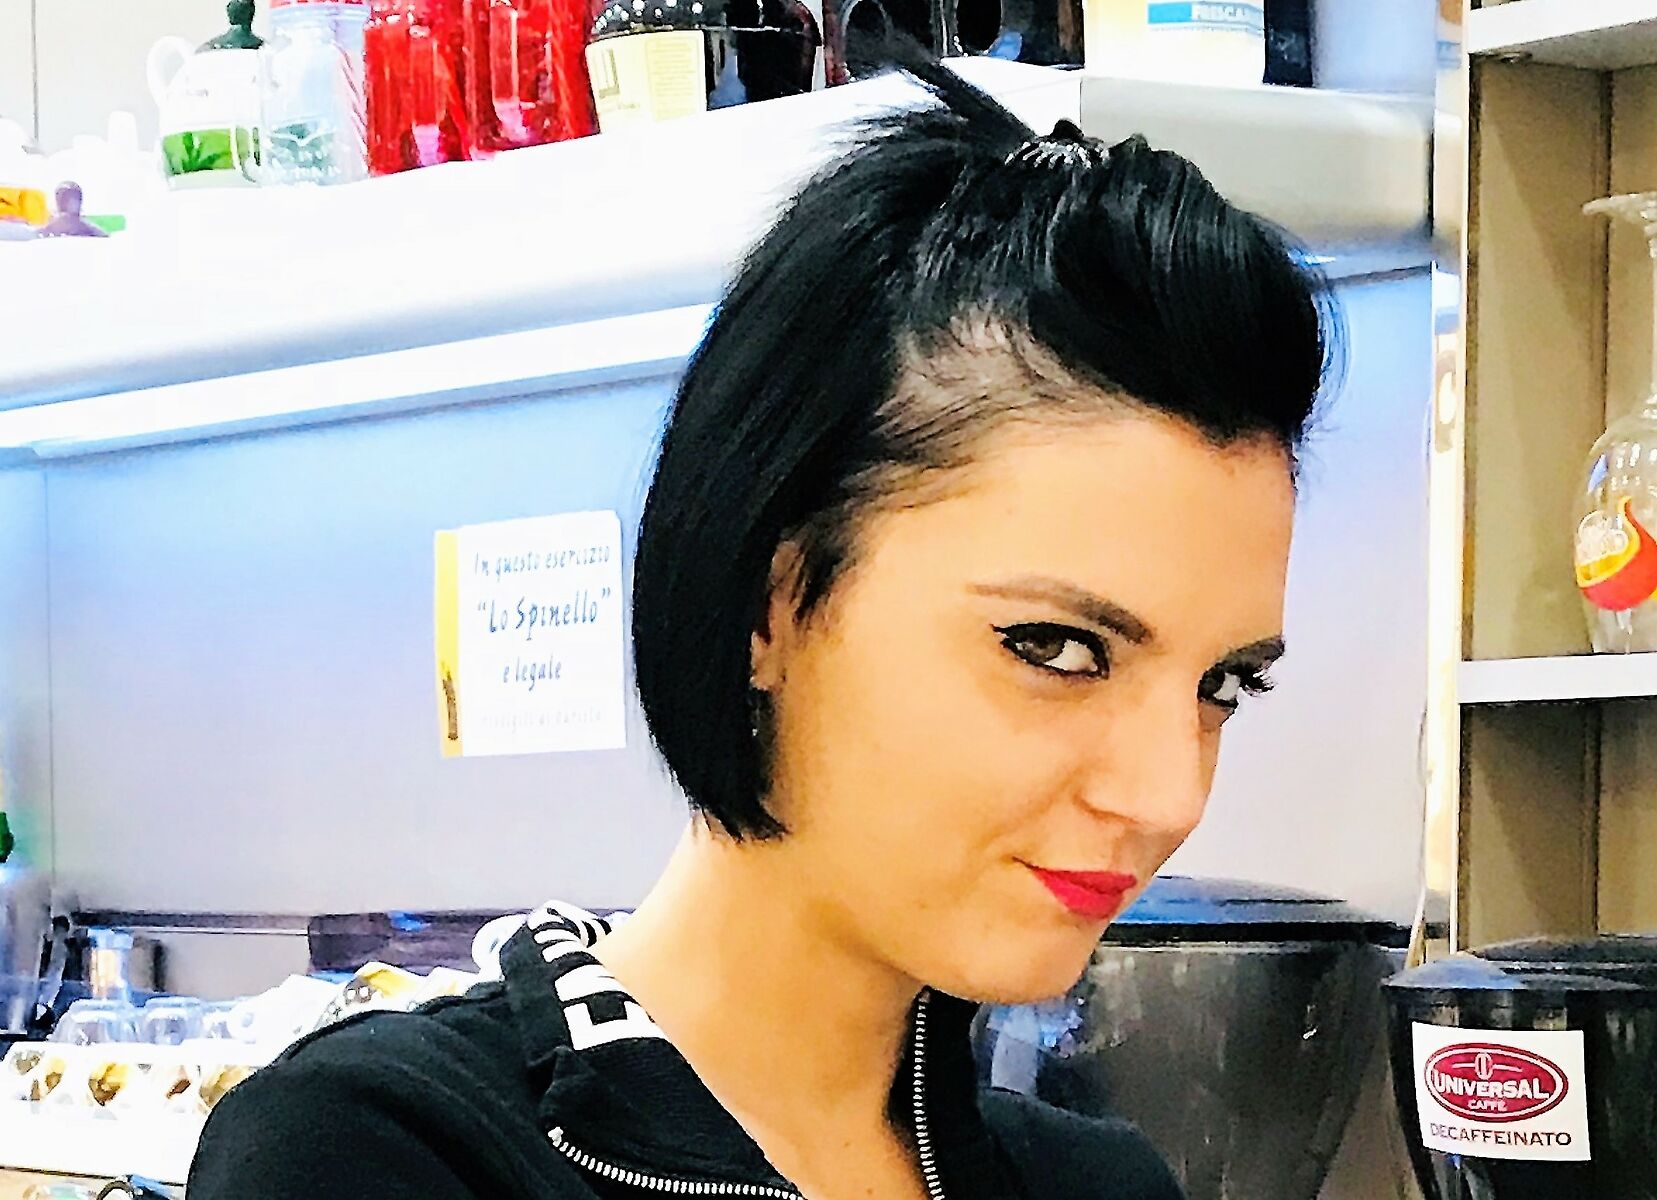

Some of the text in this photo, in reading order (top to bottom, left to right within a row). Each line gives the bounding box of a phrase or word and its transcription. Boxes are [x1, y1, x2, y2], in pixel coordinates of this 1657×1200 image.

[474, 551, 489, 577] In
[495, 550, 541, 583] questo
[515, 651, 562, 693] legale
[1431, 1067, 1550, 1100] UNIVERSAL
[1430, 1122, 1572, 1146] DECAFFEINATO
